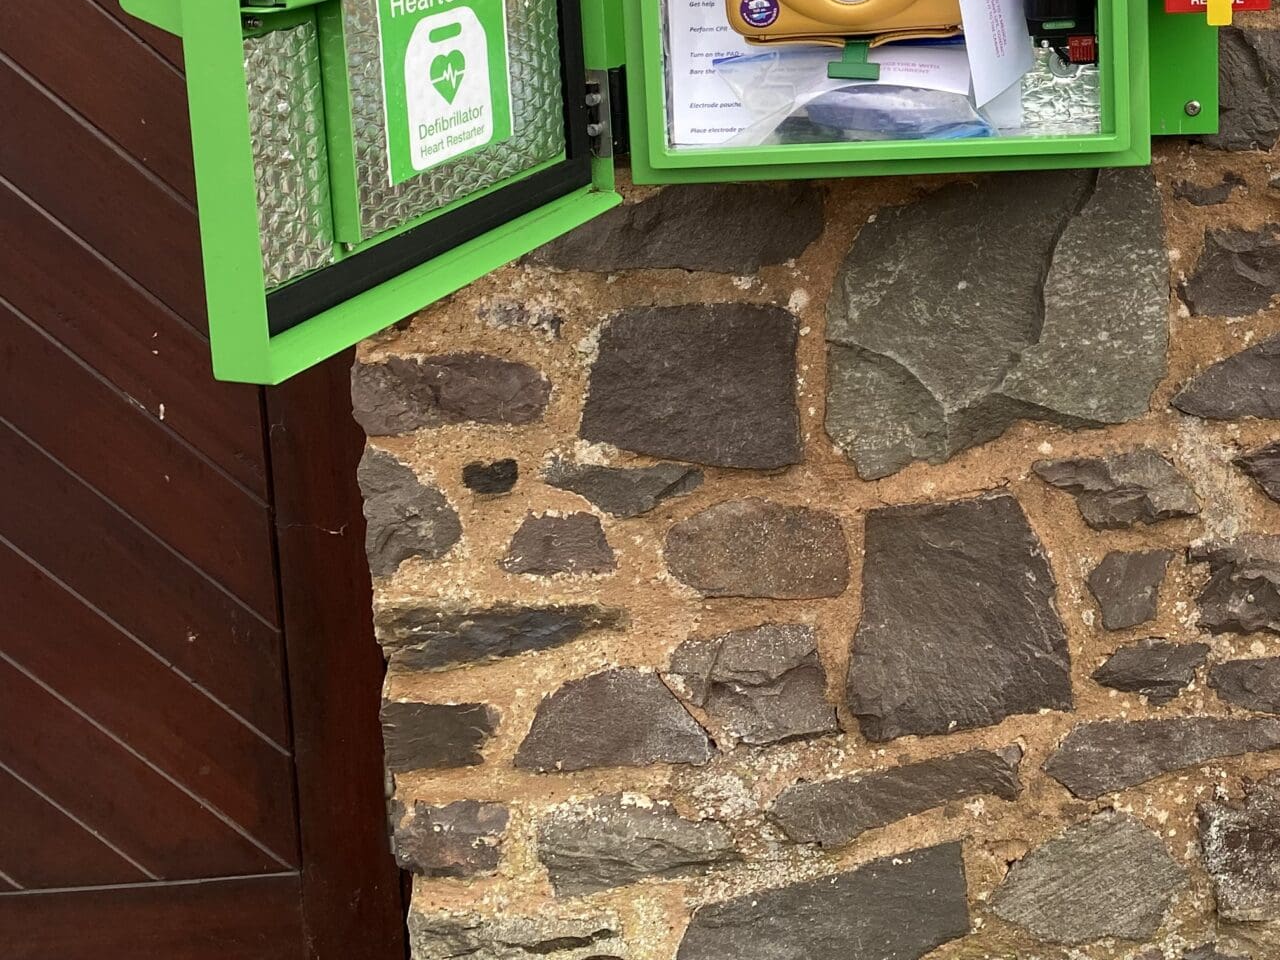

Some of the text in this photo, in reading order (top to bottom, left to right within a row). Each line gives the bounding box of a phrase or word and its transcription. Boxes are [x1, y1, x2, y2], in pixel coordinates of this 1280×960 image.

[701, 1, 715, 9] help
[689, 26, 714, 34] Perform
[418, 104, 484, 140] Defibrillator
[420, 124, 485, 158] Heart Restarter
